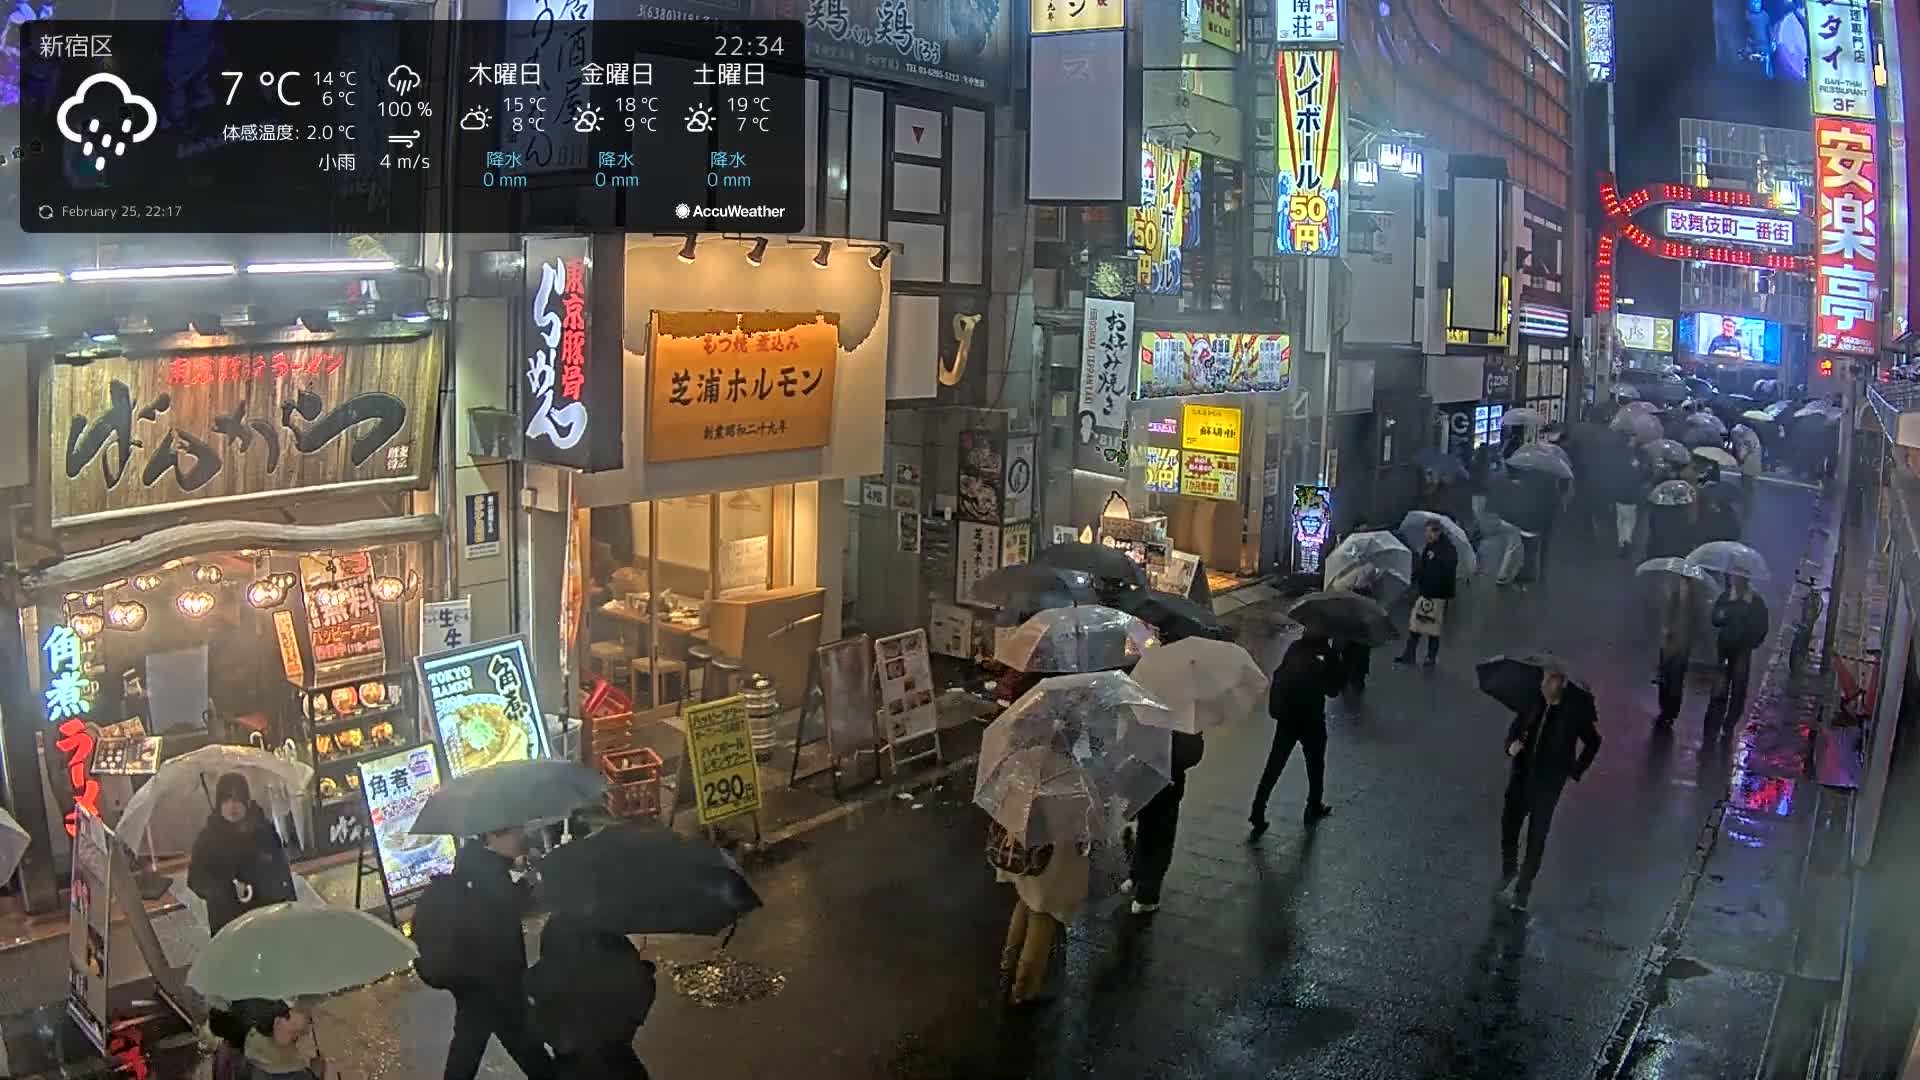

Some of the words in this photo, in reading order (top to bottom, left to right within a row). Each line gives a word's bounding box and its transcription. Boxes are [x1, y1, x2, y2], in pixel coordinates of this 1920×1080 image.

[1833, 98, 1855, 112] 3F
[1296, 54, 1322, 190] ハイボール
[1289, 195, 1328, 223] 50
[1670, 211, 1790, 242] 歌舞伎町一番街
[1818, 127, 1876, 331] 安楽亭
[562, 257, 586, 400] 東京豚骨
[668, 365, 824, 406] 芝浦ホルモン
[65, 380, 407, 492] ばんから
[428, 665, 472, 687] TOKYO
[432, 678, 474, 701] RAMEN
[368, 767, 412, 800] 角煮
